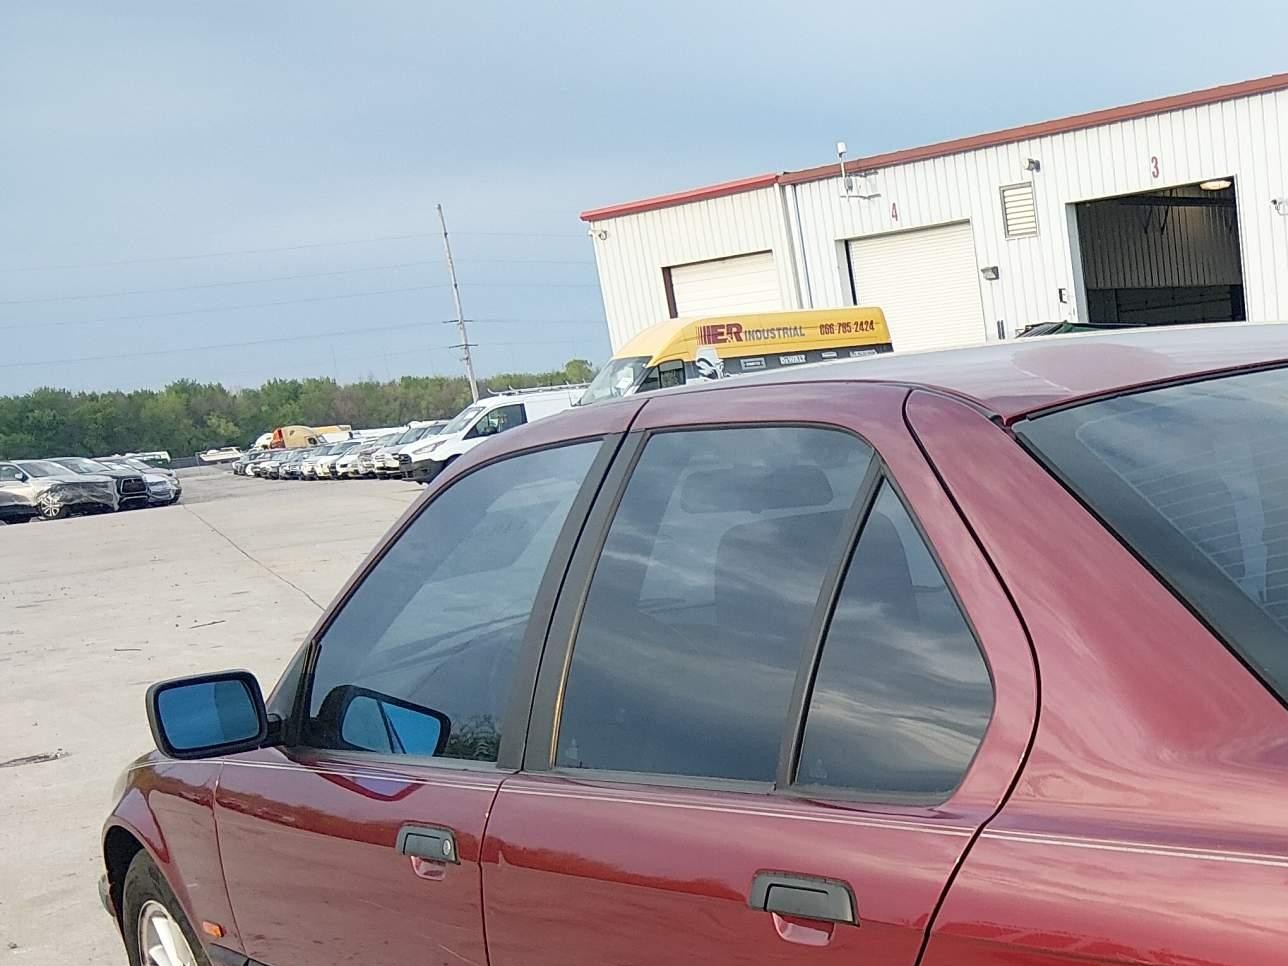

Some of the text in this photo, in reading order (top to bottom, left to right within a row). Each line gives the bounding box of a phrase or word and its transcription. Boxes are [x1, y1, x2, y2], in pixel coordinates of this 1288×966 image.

[1151, 156, 1160, 178] 3
[891, 202, 898, 221] 4
[744, 325, 805, 342] INDUSTRIAL
